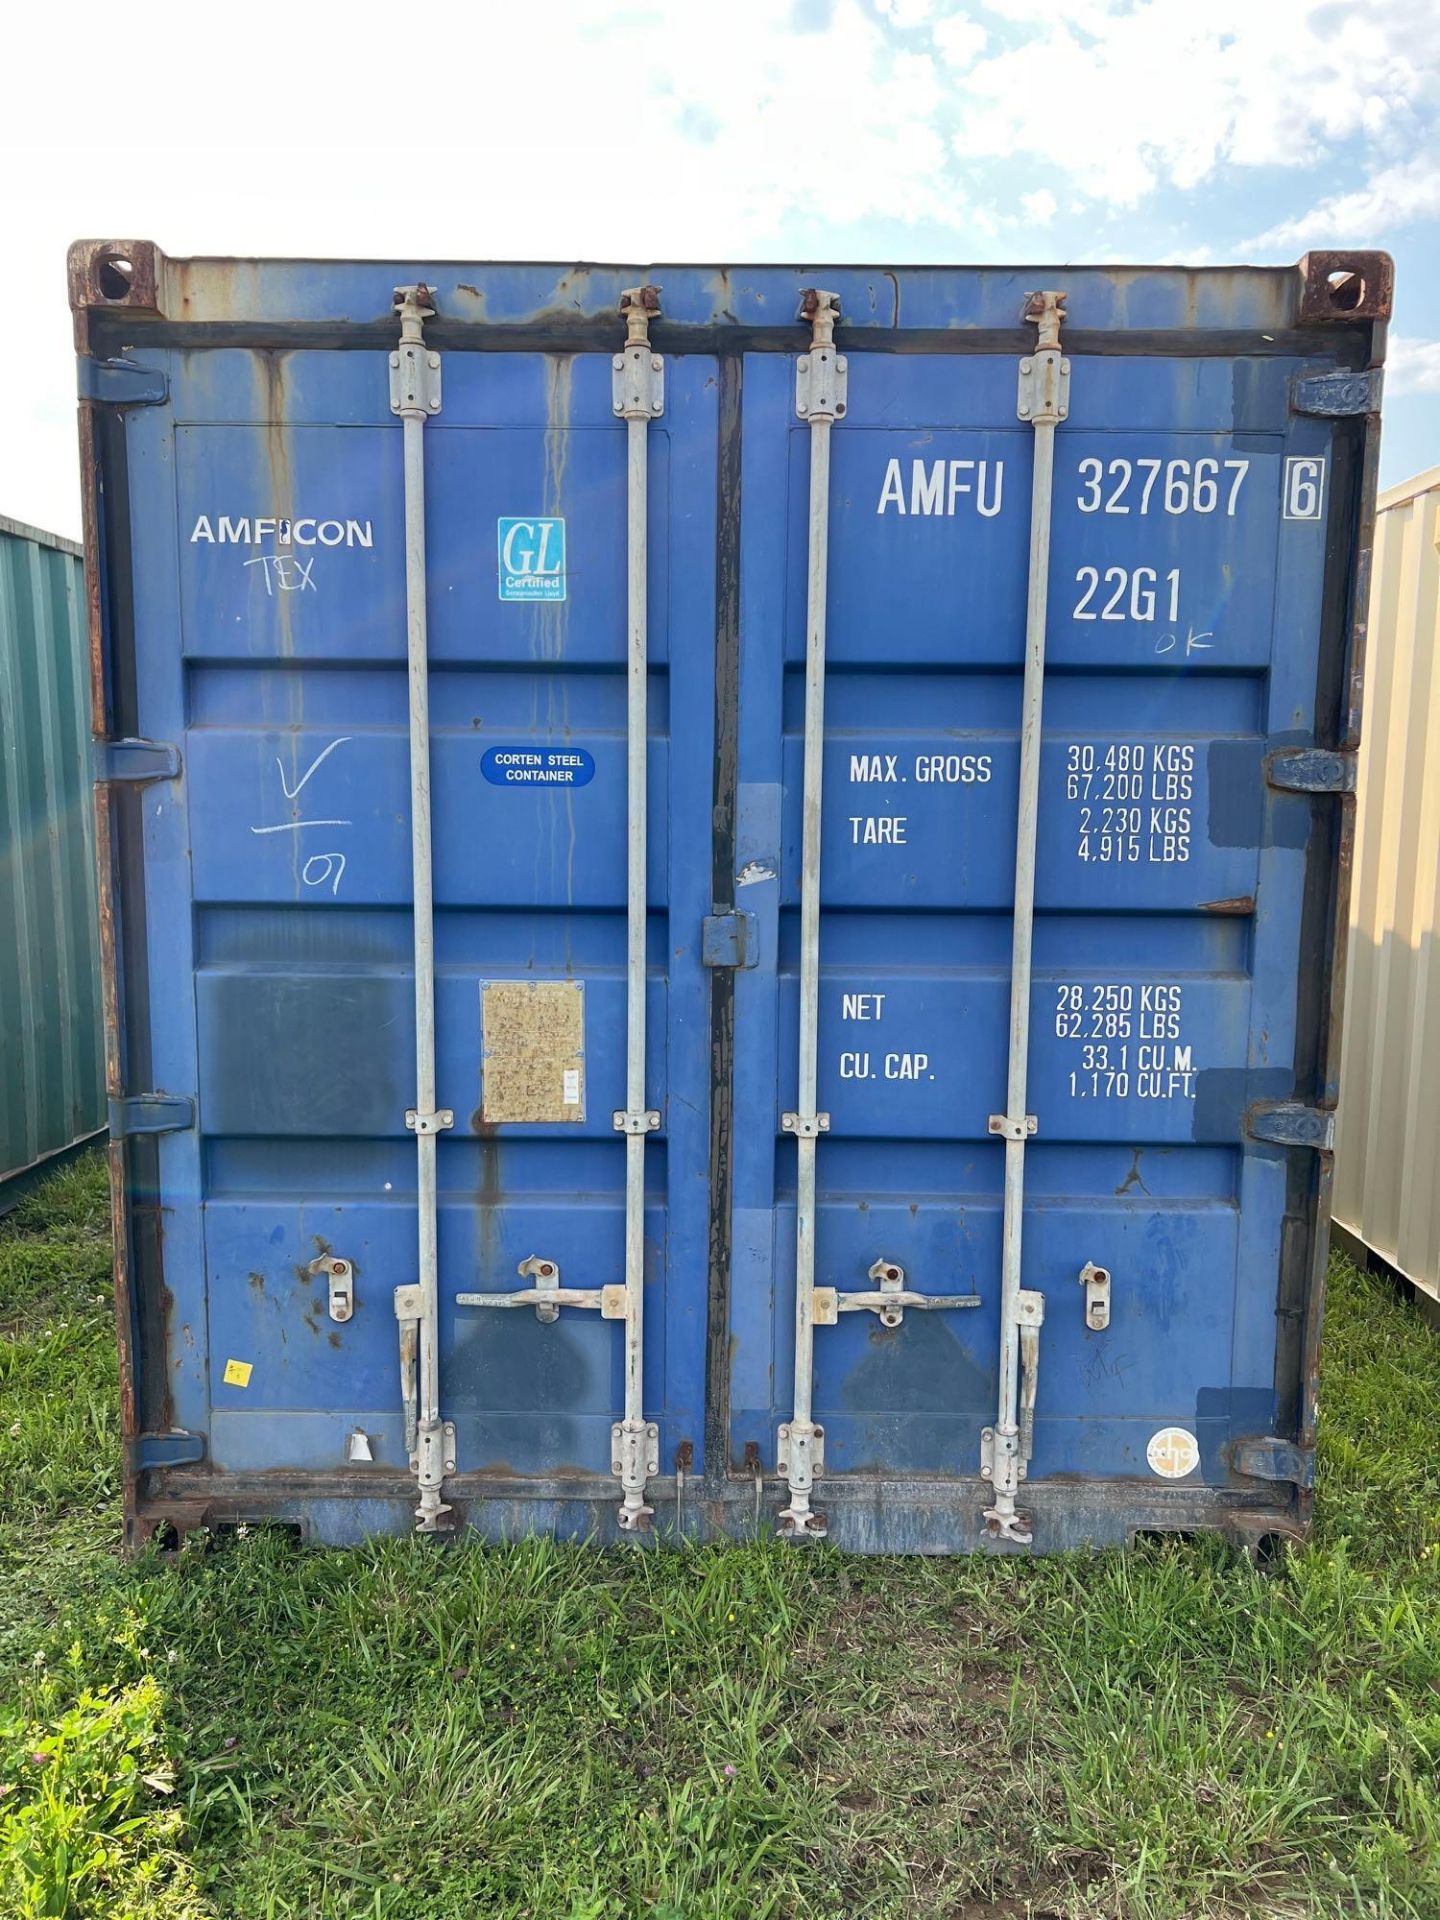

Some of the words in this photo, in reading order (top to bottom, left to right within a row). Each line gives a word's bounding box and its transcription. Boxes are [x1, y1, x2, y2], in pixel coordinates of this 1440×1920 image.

[877, 458, 1004, 517] AMFU
[1077, 457, 1249, 516] 327667
[1289, 463, 1319, 517] 6
[503, 522, 560, 575] GL
[243, 555, 317, 596] TEX
[505, 577, 560, 588] Certified
[1072, 565, 1182, 622] 22G1
[495, 753, 541, 766] CORTEN
[548, 755, 584, 767] STEEL
[849, 755, 907, 783] MAX.
[915, 756, 992, 783] GROSS
[1153, 745, 1194, 772] KGS
[506, 769, 573, 782] CONTAINER
[1152, 774, 1193, 800] LBS
[849, 817, 907, 845] TARE
[1150, 807, 1191, 834] KGS
[1149, 835, 1191, 862] LBS
[843, 994, 886, 1021] NET
[1140, 985, 1181, 1012] KGS
[1139, 1013, 1181, 1038] LBS
[840, 1052, 877, 1079] CU.
[885, 1053, 936, 1080] CAP.
[1082, 1045, 1127, 1070] 33.1
[1138, 1045, 1197, 1071] CU.M.
[1137, 1072, 1197, 1098] CU.FT.
